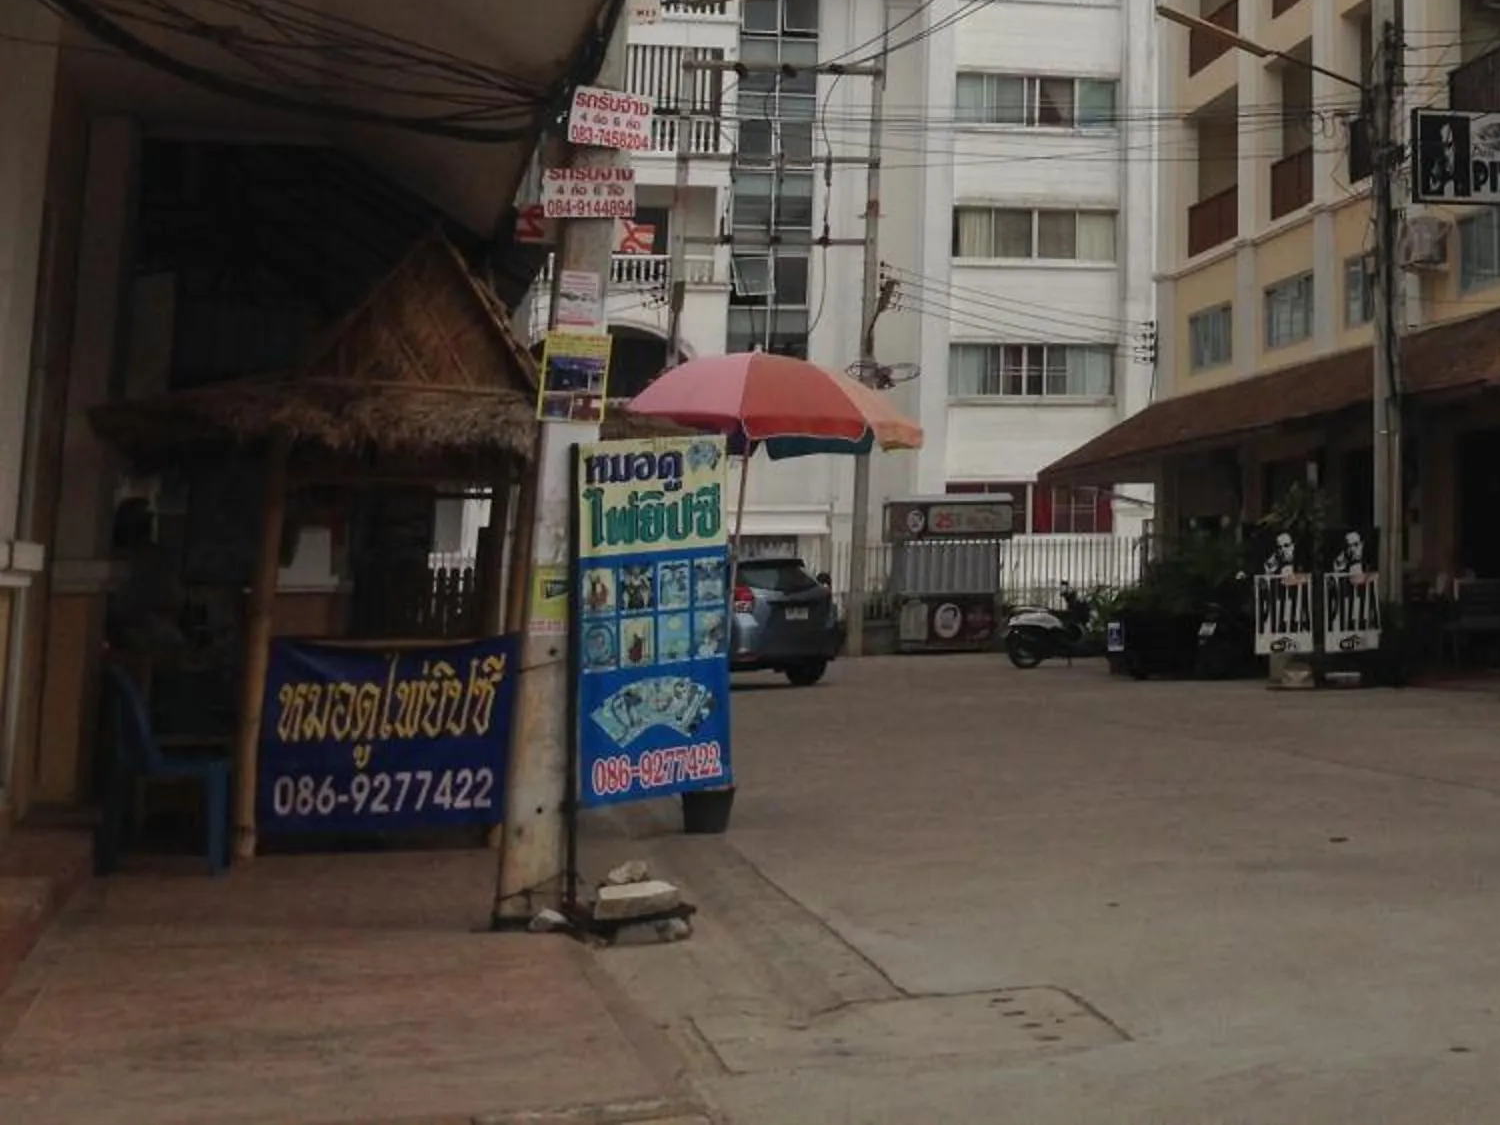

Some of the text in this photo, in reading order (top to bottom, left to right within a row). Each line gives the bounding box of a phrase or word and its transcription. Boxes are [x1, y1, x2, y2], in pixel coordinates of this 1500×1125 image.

[584, 450, 684, 492] หมอดู
[1258, 576, 1313, 634] PIZZA
[1325, 575, 1380, 633] PIZZA
[273, 767, 495, 816] 086-9277422
[592, 741, 722, 796] 086-9277422
